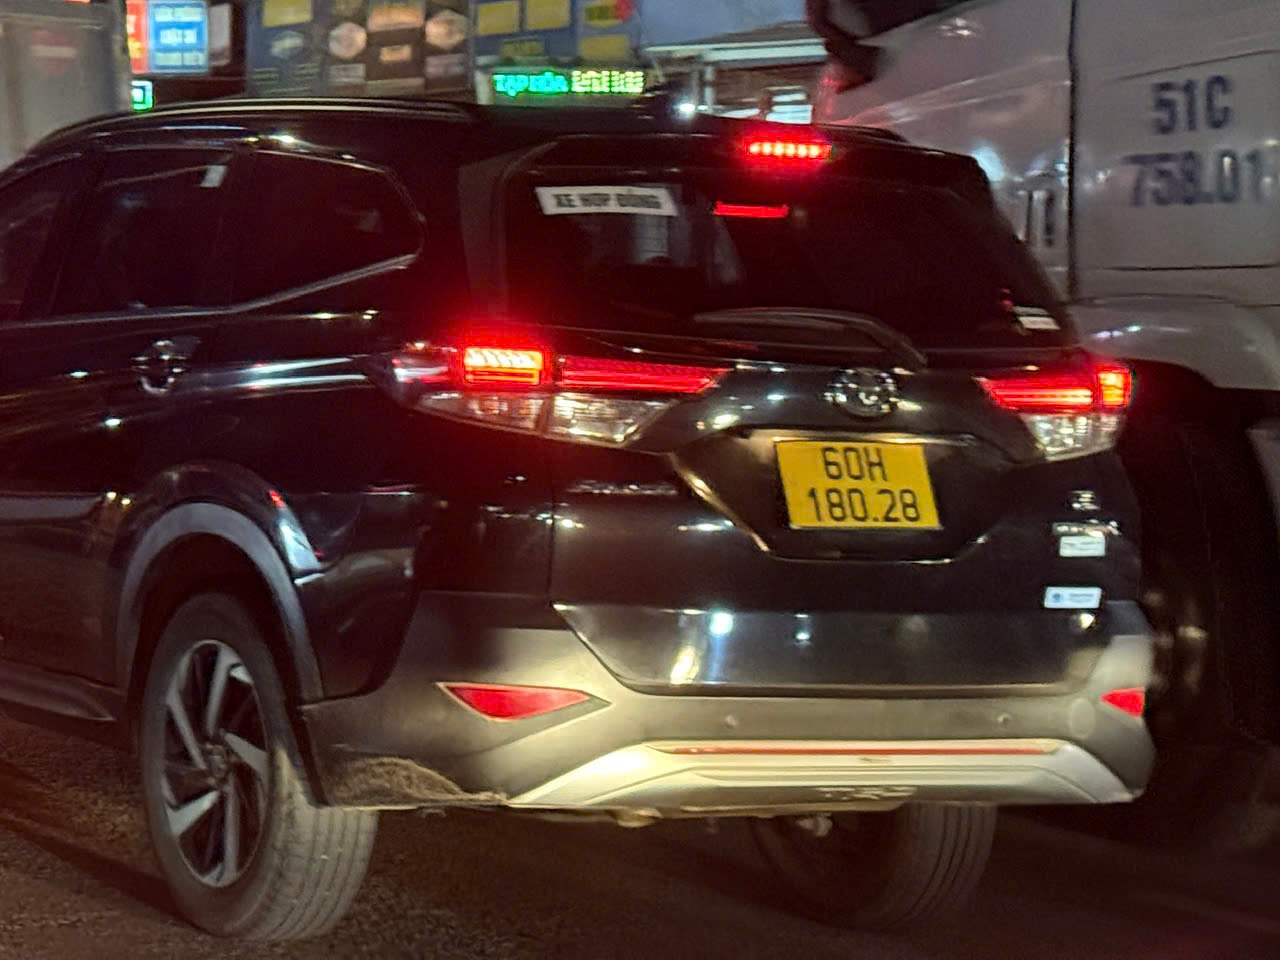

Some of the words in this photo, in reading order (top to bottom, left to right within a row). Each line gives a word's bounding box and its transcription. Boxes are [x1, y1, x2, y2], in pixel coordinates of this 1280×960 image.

[1152, 76, 1232, 136] 51C
[821, 445, 889, 482] 60H
[807, 487, 921, 523] 180.28
